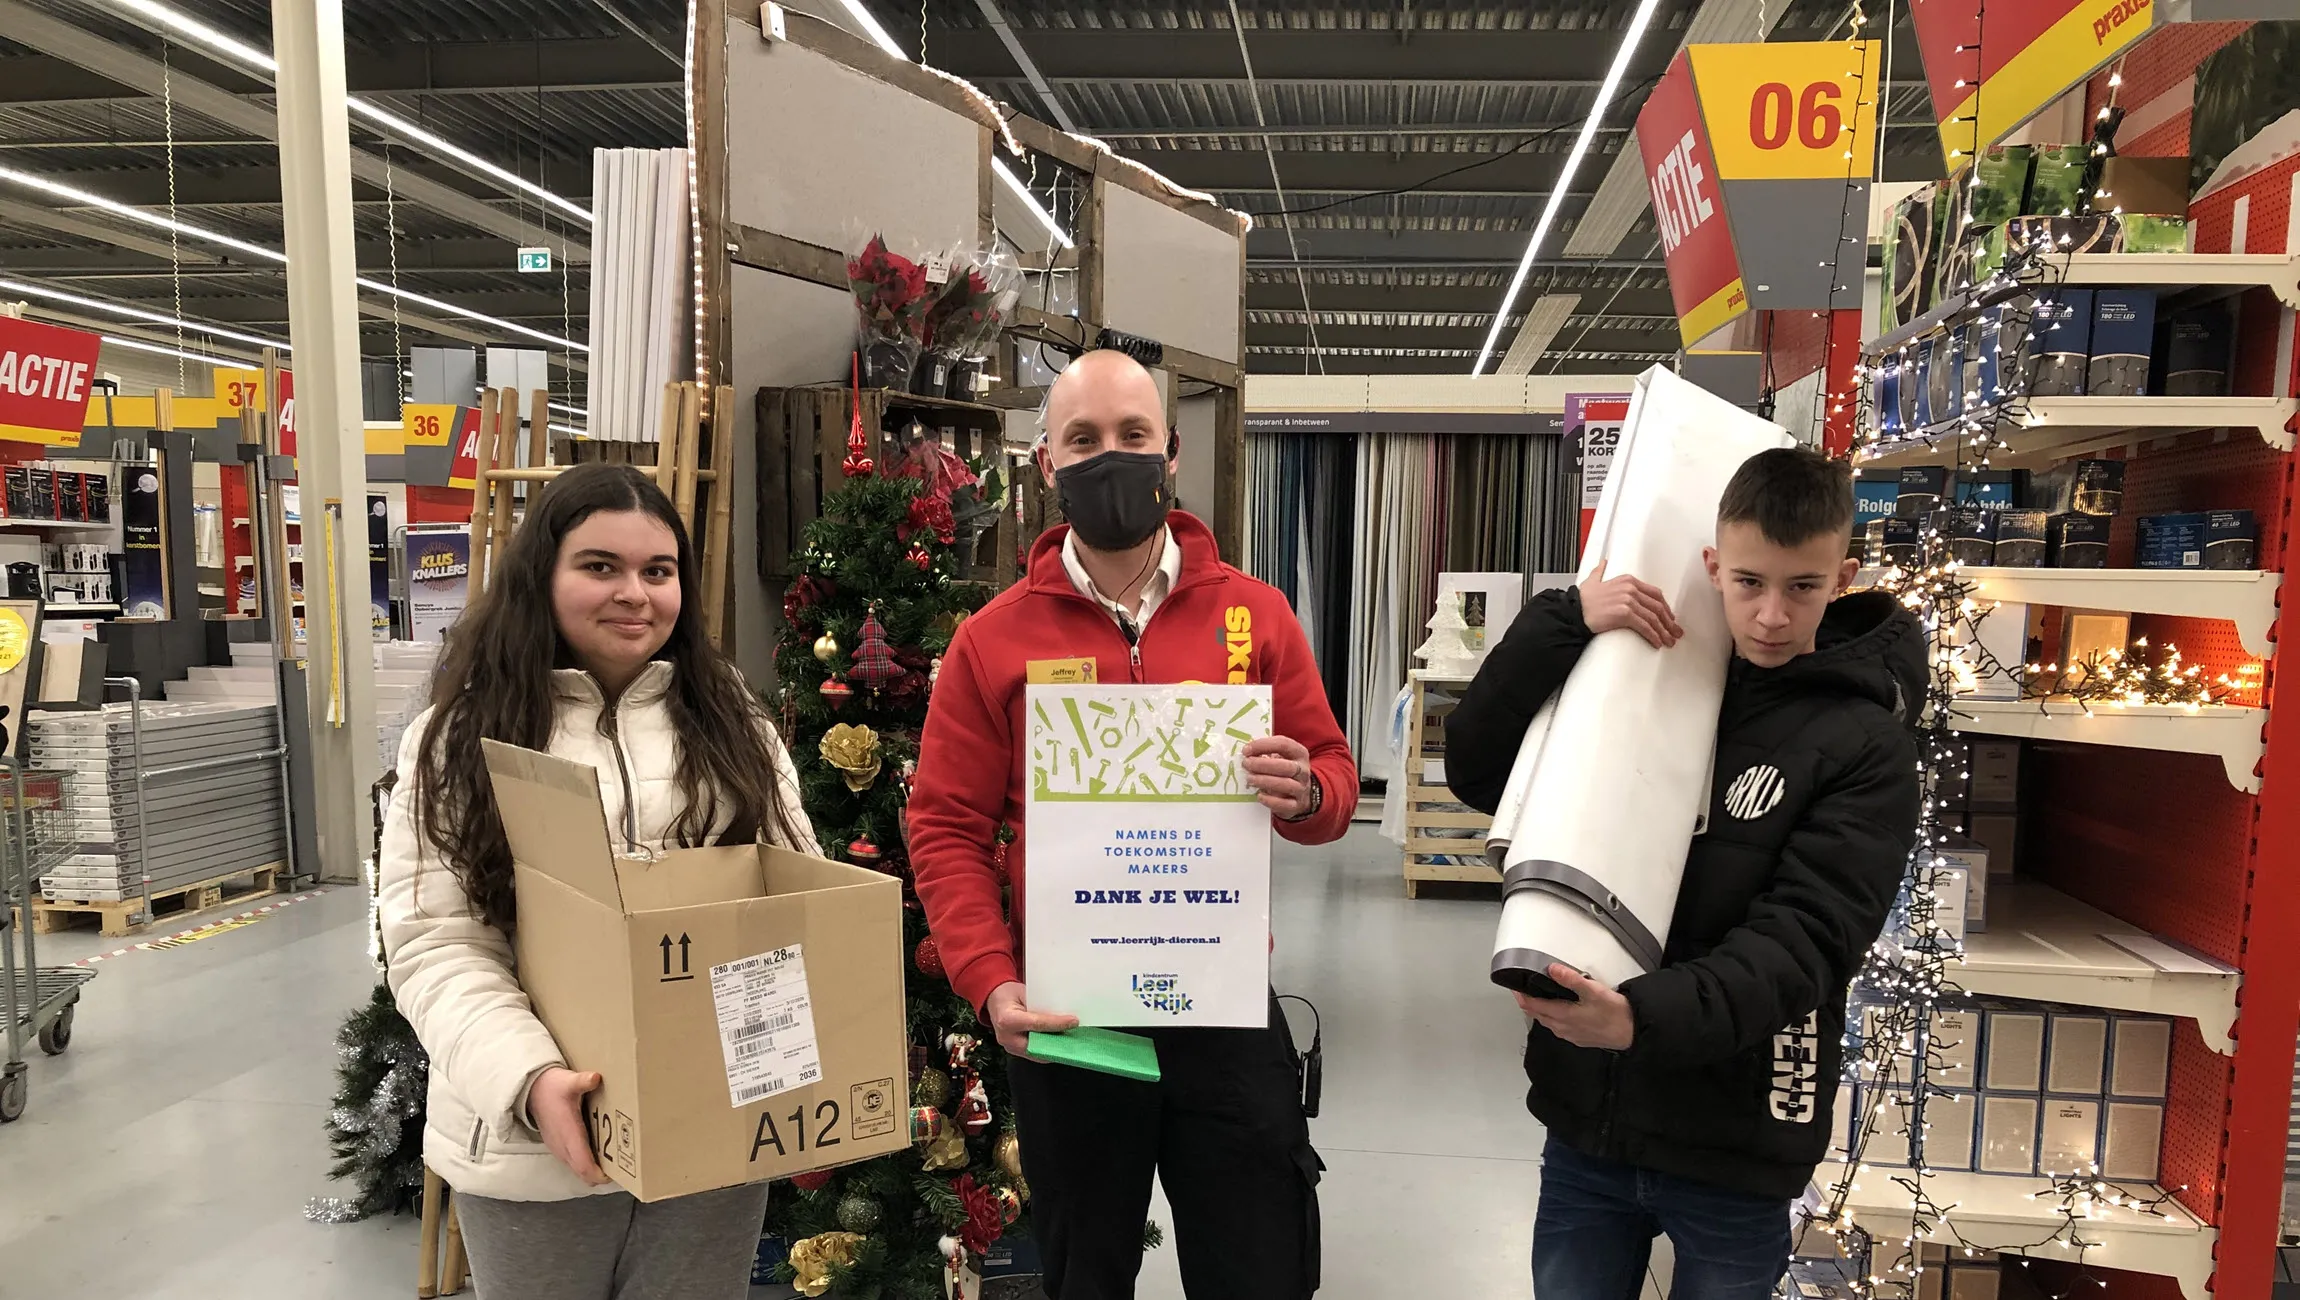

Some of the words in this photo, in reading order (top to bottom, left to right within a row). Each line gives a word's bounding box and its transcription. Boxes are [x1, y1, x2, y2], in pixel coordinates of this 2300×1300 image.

[1749, 81, 1842, 149] 06
[1651, 128, 1714, 257] ACTIE
[1726, 288, 1745, 311] praxis
[0, 350, 88, 402] ACTIE
[228, 382, 258, 407] 37
[413, 415, 440, 437] 36
[1244, 418, 1284, 427] ransparant
[1284, 418, 1290, 426] &
[1291, 418, 1330, 426] Inbetween
[1549, 419, 1564, 427] Sem
[1588, 427, 1620, 446] 25
[1588, 447, 1615, 457] KOR
[420, 552, 454, 568] KLUS
[412, 563, 468, 581] KNALLERS
[1050, 668, 1077, 677] Jeffrey
[1116, 830, 1177, 840] NAMENS
[1185, 830, 1202, 840] DE
[1104, 847, 1212, 857] TOEKOMSTIGE
[1128, 864, 1189, 874] MAKERS
[1074, 890, 1142, 904] DANK
[1149, 890, 1176, 904] JE
[1183, 890, 1240, 904] WEL!
[1090, 936, 1221, 946] www.leerrijk-dieren.nl
[713, 964, 728, 976] 280
[732, 958, 760, 973] 001/001
[1132, 974, 1178, 992] Leer
[1153, 992, 1193, 1015] Rijk
[798, 1068, 818, 1081] 2036
[592, 1106, 614, 1163] 12
[749, 1099, 841, 1162] A12
